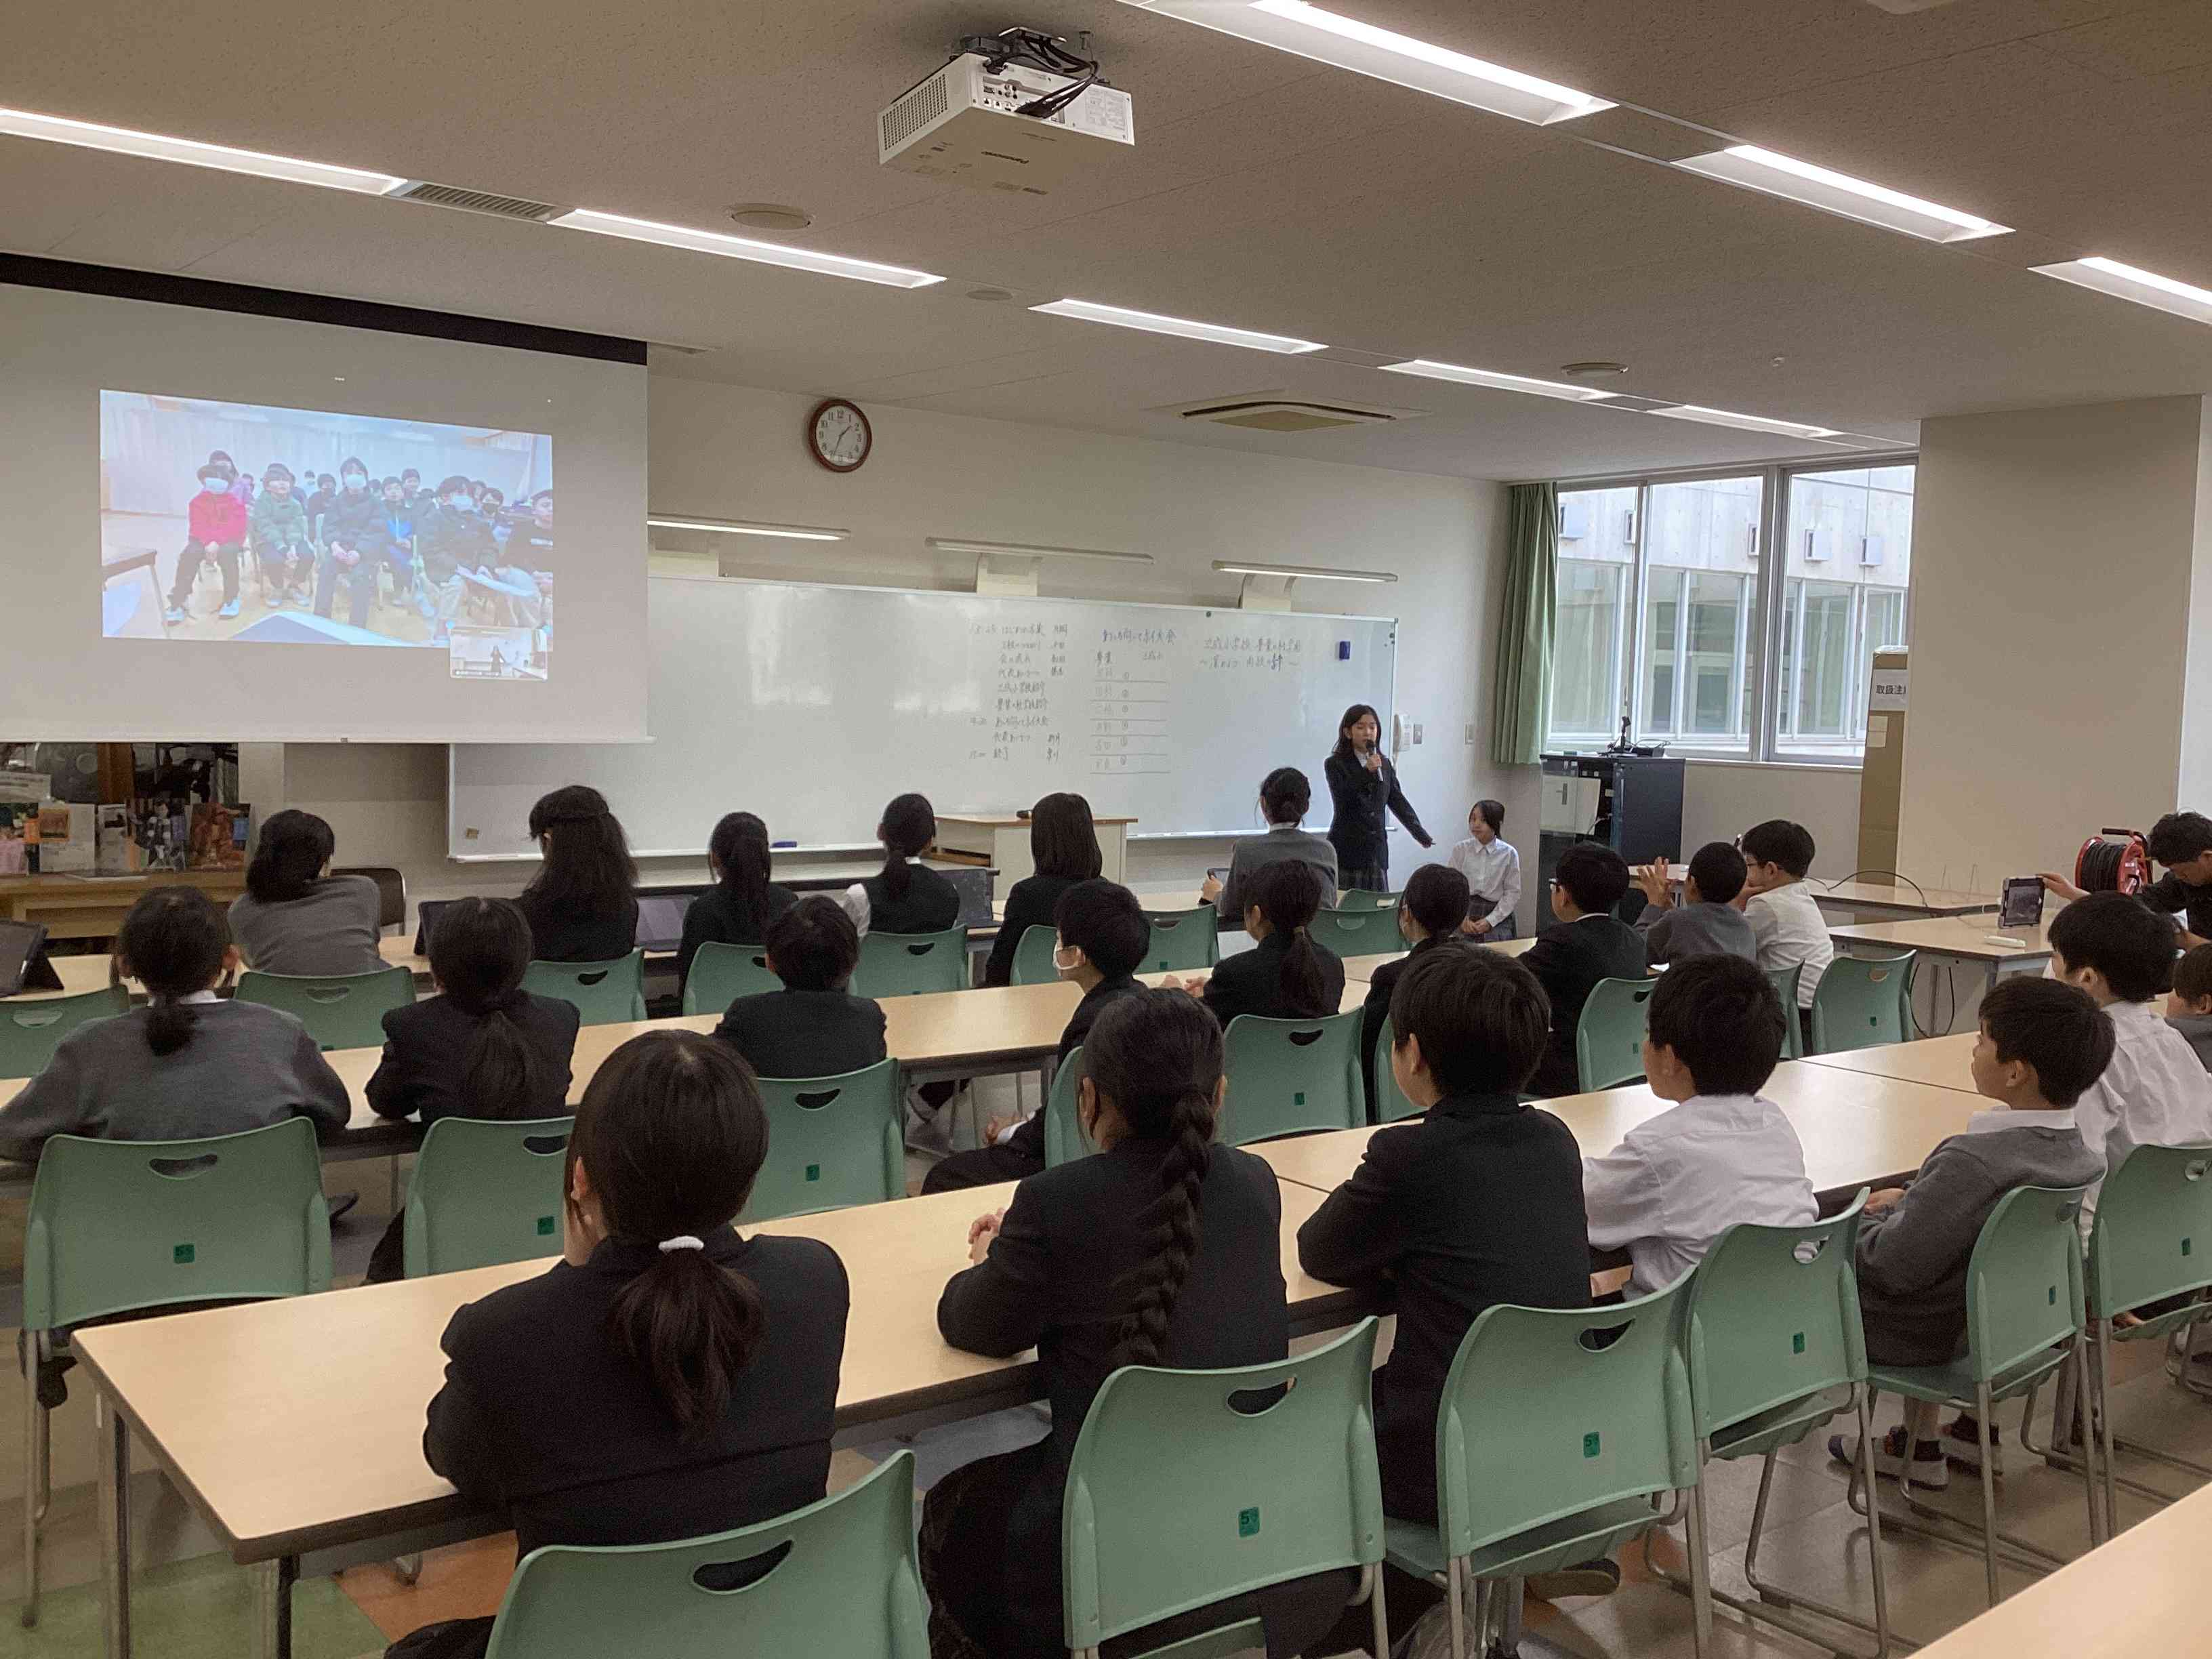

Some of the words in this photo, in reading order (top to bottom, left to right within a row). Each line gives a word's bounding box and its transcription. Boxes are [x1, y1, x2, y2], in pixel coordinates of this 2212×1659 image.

[828, 412, 834, 420] 11
[837, 409, 844, 418] 12
[855, 423, 859, 431] 2
[1876, 684, 1906, 695] 取扱注
[1241, 1511, 1250, 1525] 5
